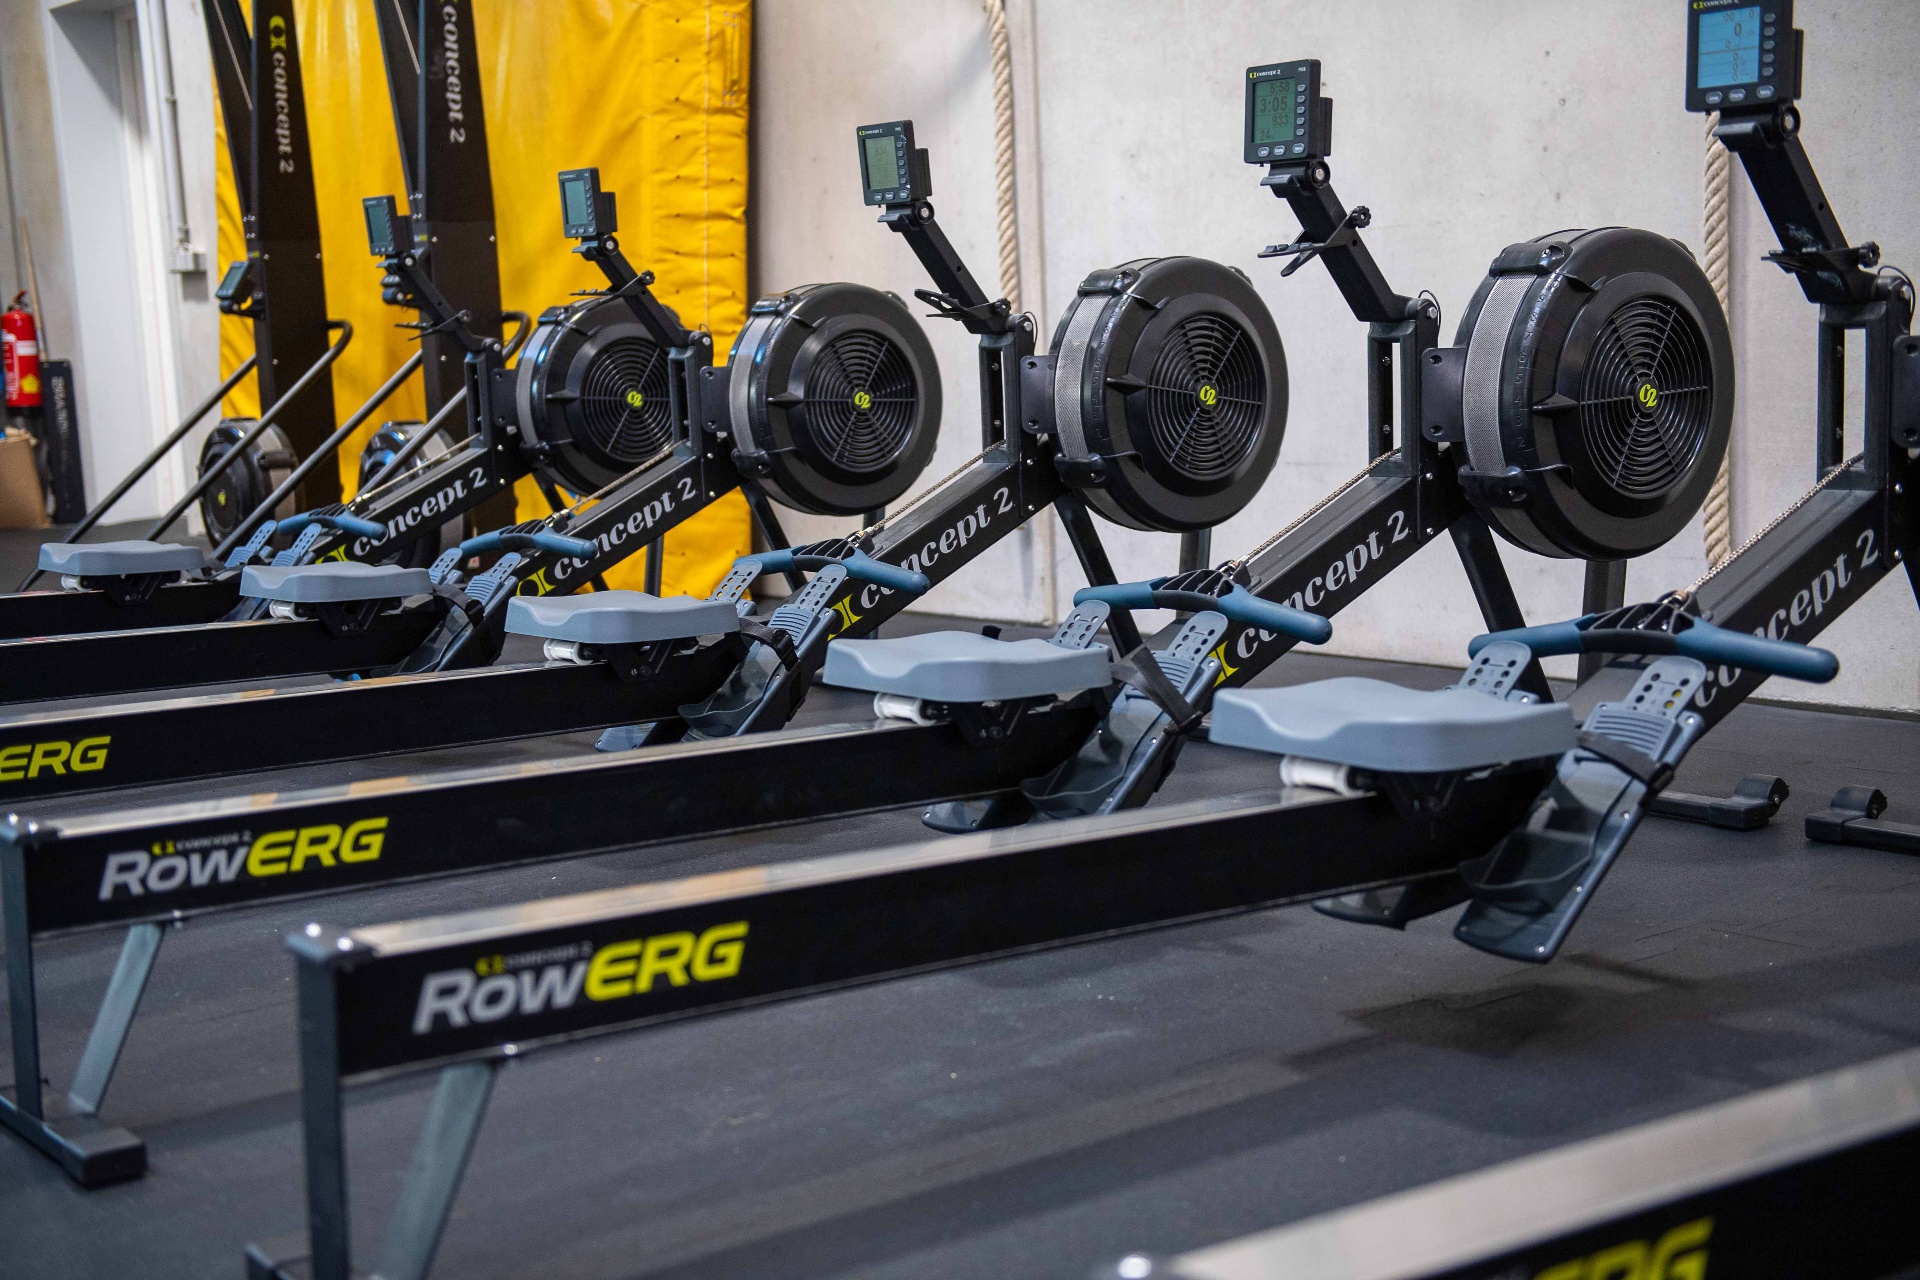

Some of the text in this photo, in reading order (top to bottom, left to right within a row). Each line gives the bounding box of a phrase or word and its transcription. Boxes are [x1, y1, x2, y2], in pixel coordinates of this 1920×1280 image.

[442, 5, 466, 144] concept 2
[272, 51, 295, 174] concept 2
[469, 466, 488, 489] 2
[677, 477, 696, 502] 2
[993, 486, 1013, 516] 2
[1387, 510, 1409, 544] 2
[1856, 529, 1879, 569] 2
